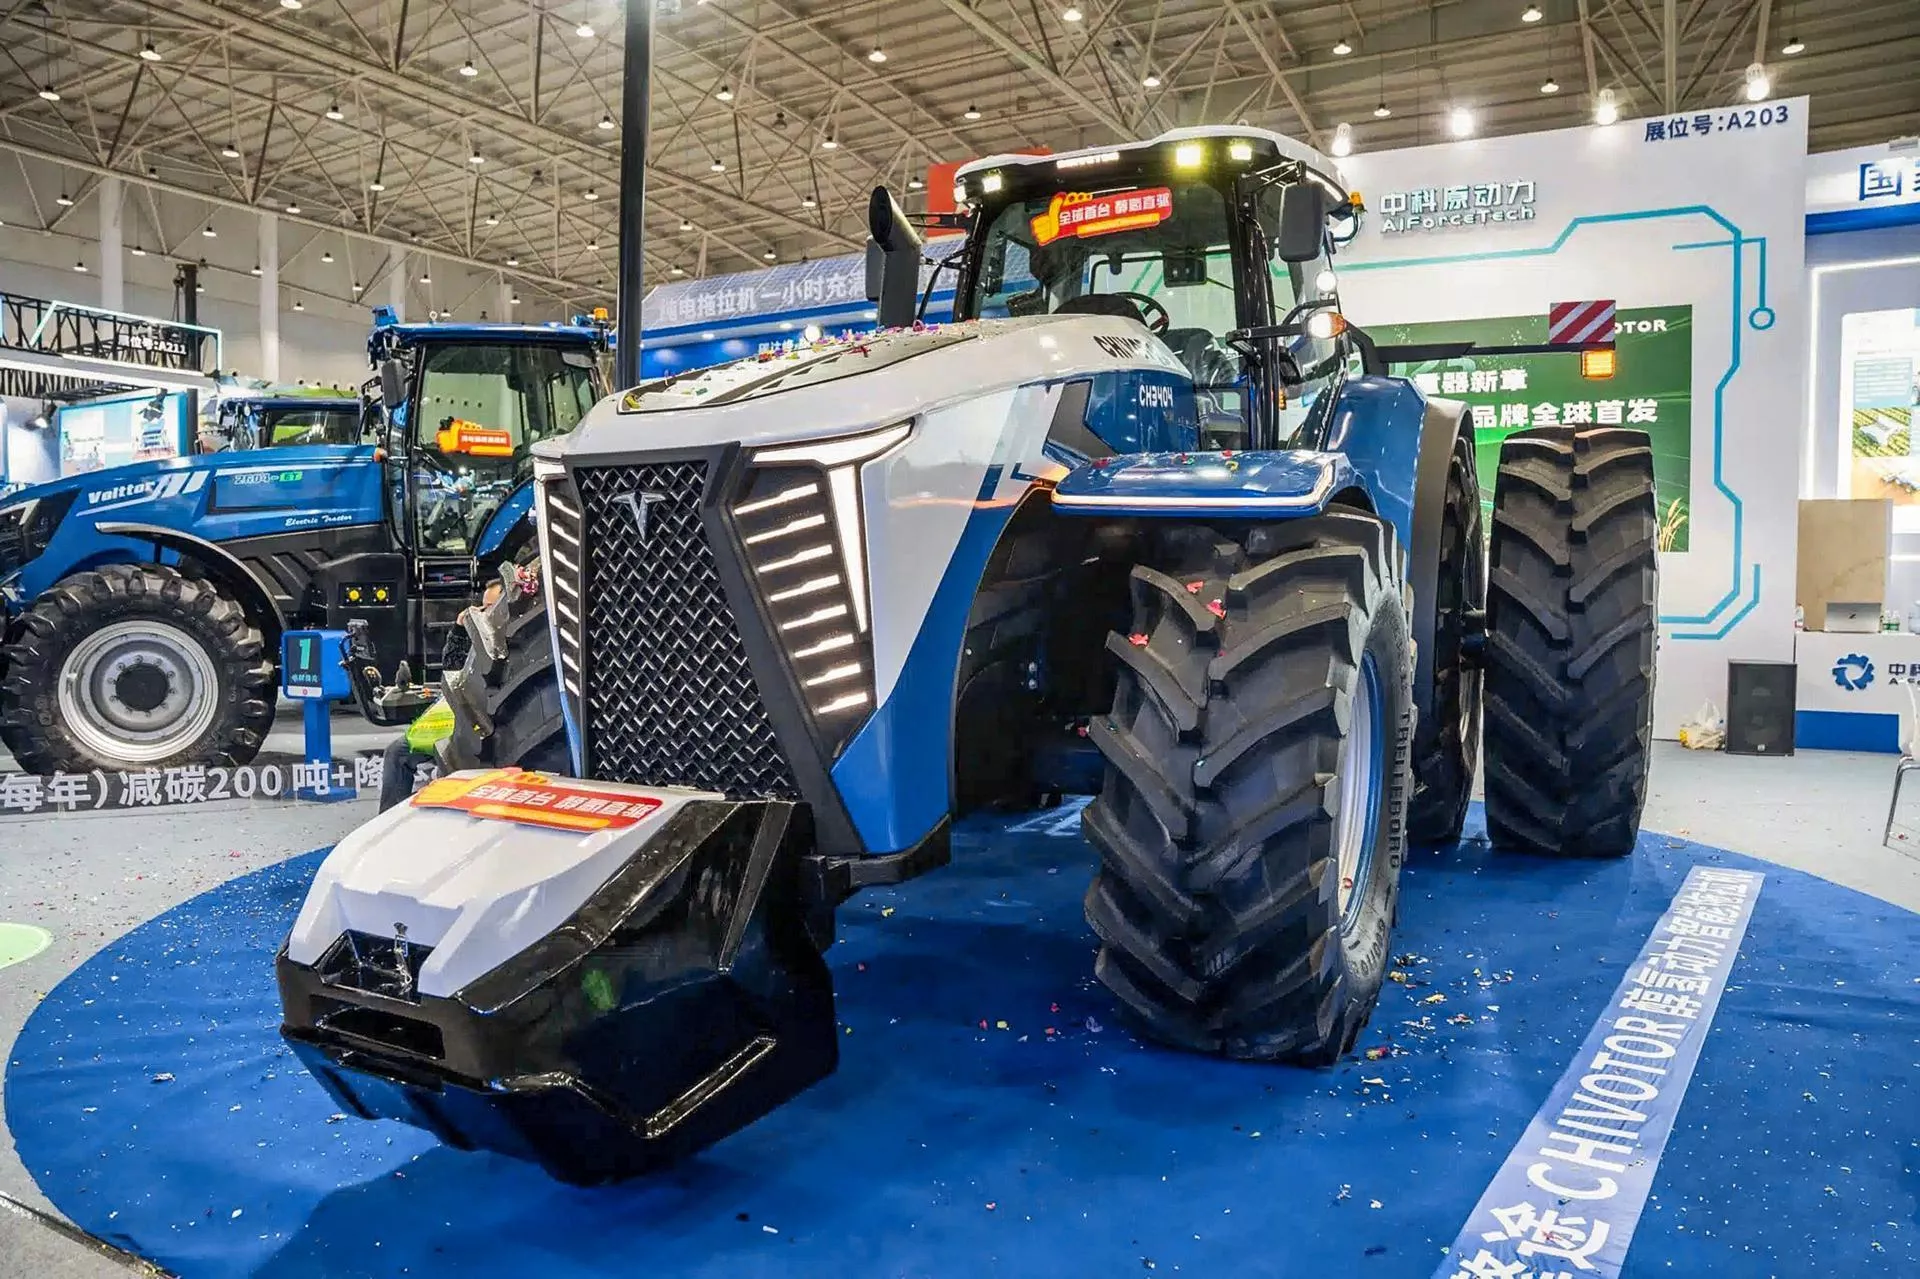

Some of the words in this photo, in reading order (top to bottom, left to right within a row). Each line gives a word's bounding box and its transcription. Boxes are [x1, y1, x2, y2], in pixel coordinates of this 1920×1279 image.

[1645, 105, 1789, 142] 展位号:A203
[1381, 178, 1536, 216] 中科原动力
[1859, 161, 1920, 201] 国
[1139, 384, 1174, 408] CH3404
[1472, 398, 1658, 427] 品牌全球首发
[299, 638, 311, 670] 1
[1527, 1016, 1687, 1200] CHIVOTOR
